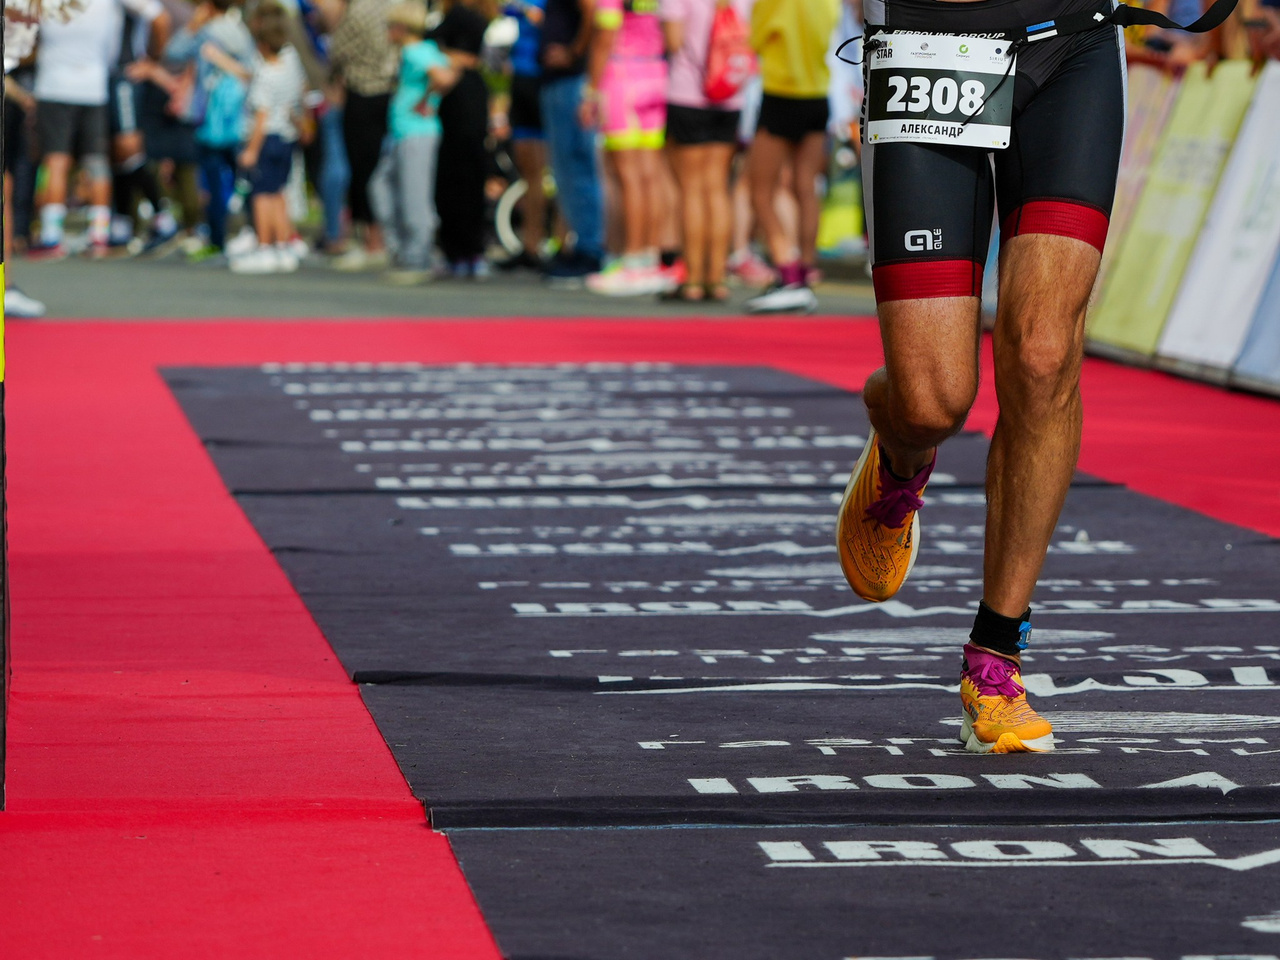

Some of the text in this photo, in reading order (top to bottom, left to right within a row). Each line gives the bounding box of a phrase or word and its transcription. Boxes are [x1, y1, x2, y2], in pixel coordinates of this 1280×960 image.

[876, 48, 893, 60] STAR
[886, 75, 986, 117] 2308
[900, 123, 964, 138] АЛЕКСАНДР
[687, 773, 1102, 795] IRON
[756, 836, 1217, 862] IRON
